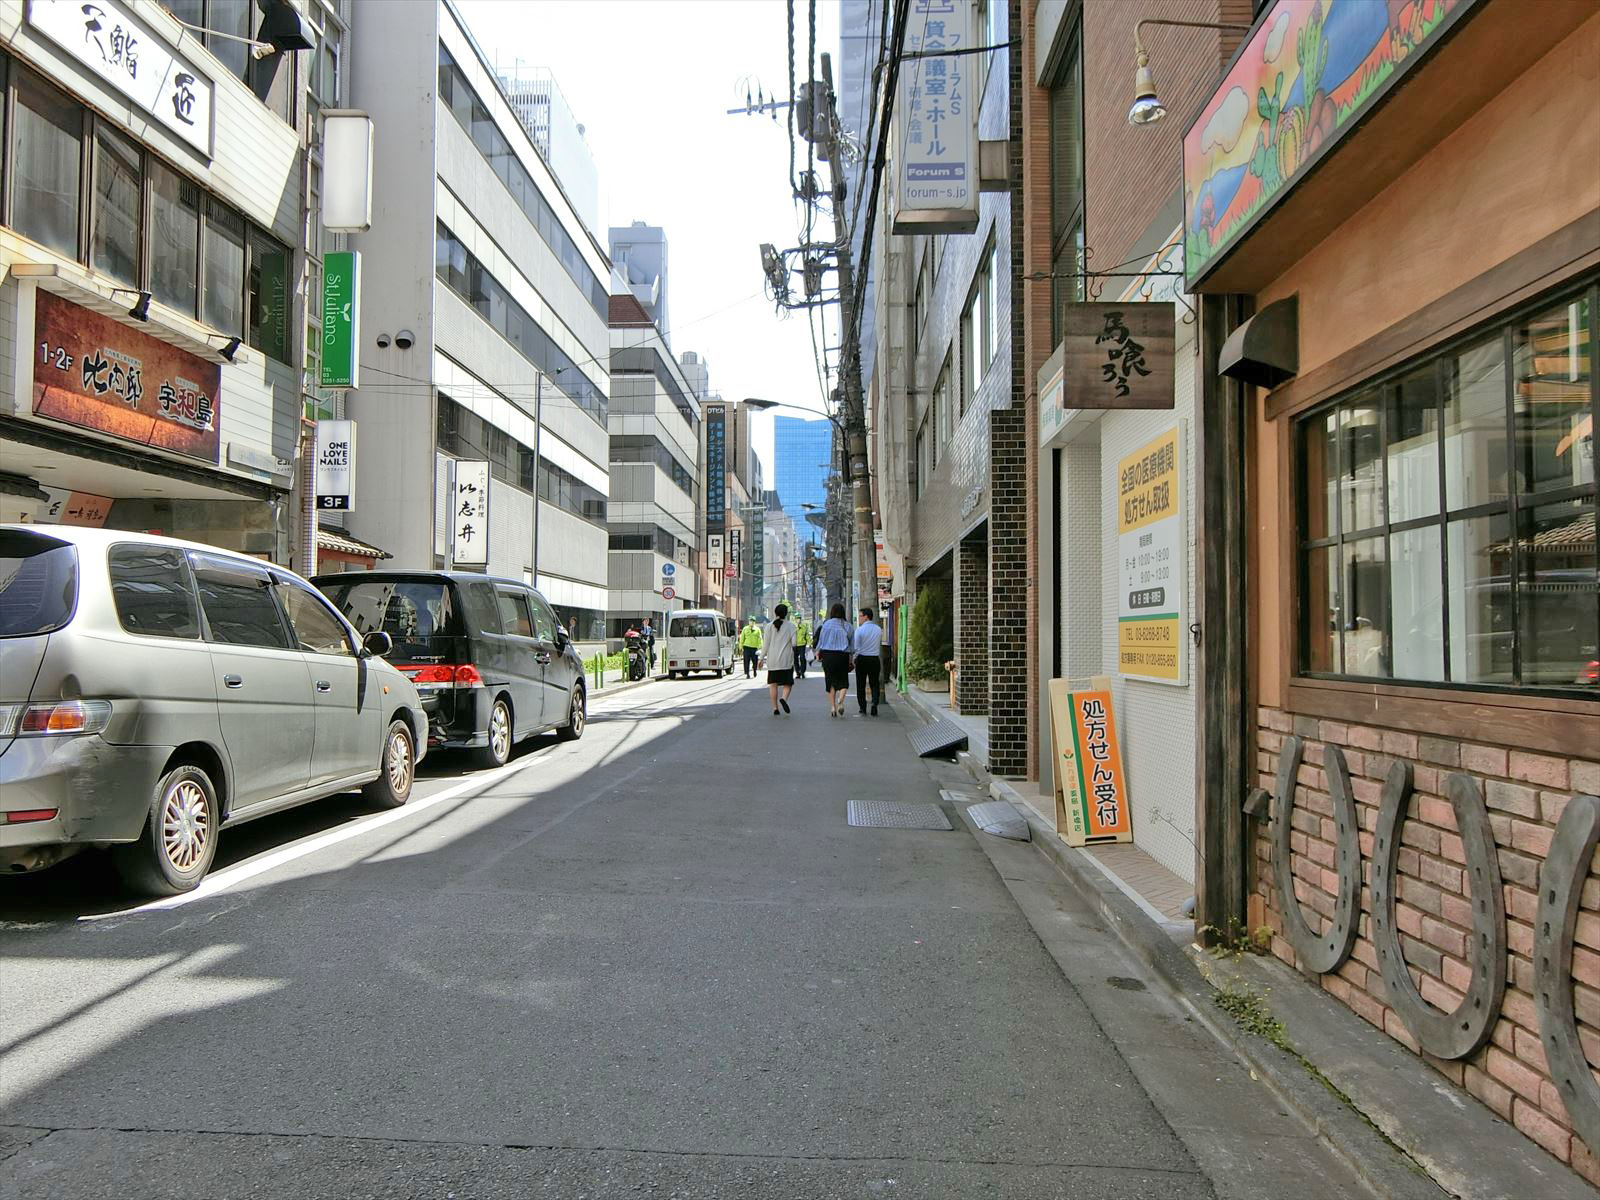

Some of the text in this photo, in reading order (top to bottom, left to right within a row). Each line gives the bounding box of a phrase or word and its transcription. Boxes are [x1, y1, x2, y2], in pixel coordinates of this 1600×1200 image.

[950, 34, 961, 115] フーラムS
[907, 186, 966, 199] forum-s.jp
[908, 167, 965, 177] Forum S
[158, 380, 213, 423] 宇和島
[329, 441, 348, 449] ONE
[1121, 441, 1174, 495] 全国の医療機関
[324, 497, 342, 507] 3F
[1125, 480, 1169, 525] 処方せん取扱
[1082, 699, 1118, 827] 処方せん受付
